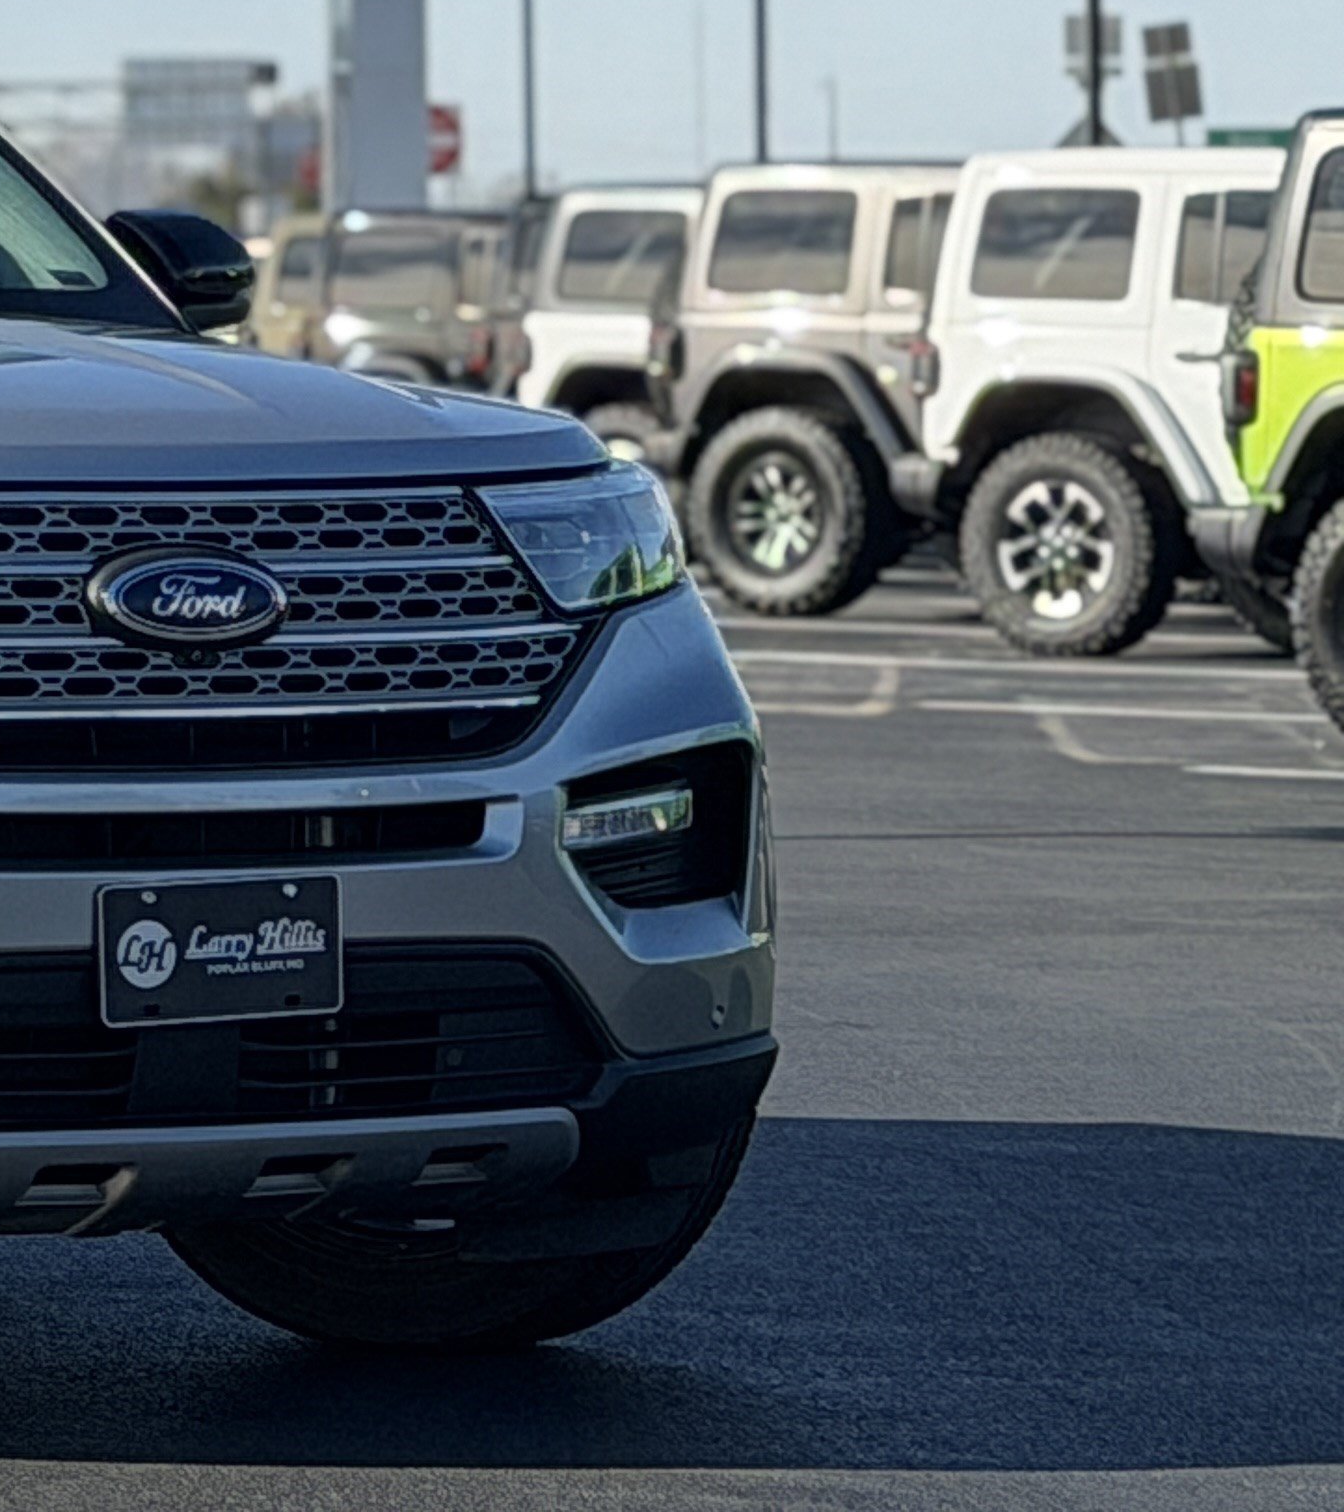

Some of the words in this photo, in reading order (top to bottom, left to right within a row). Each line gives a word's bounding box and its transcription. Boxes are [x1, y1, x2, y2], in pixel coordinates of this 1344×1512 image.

[152, 573, 247, 619] Ford
[184, 925, 254, 961] Larry
[256, 917, 326, 955] Hillis
